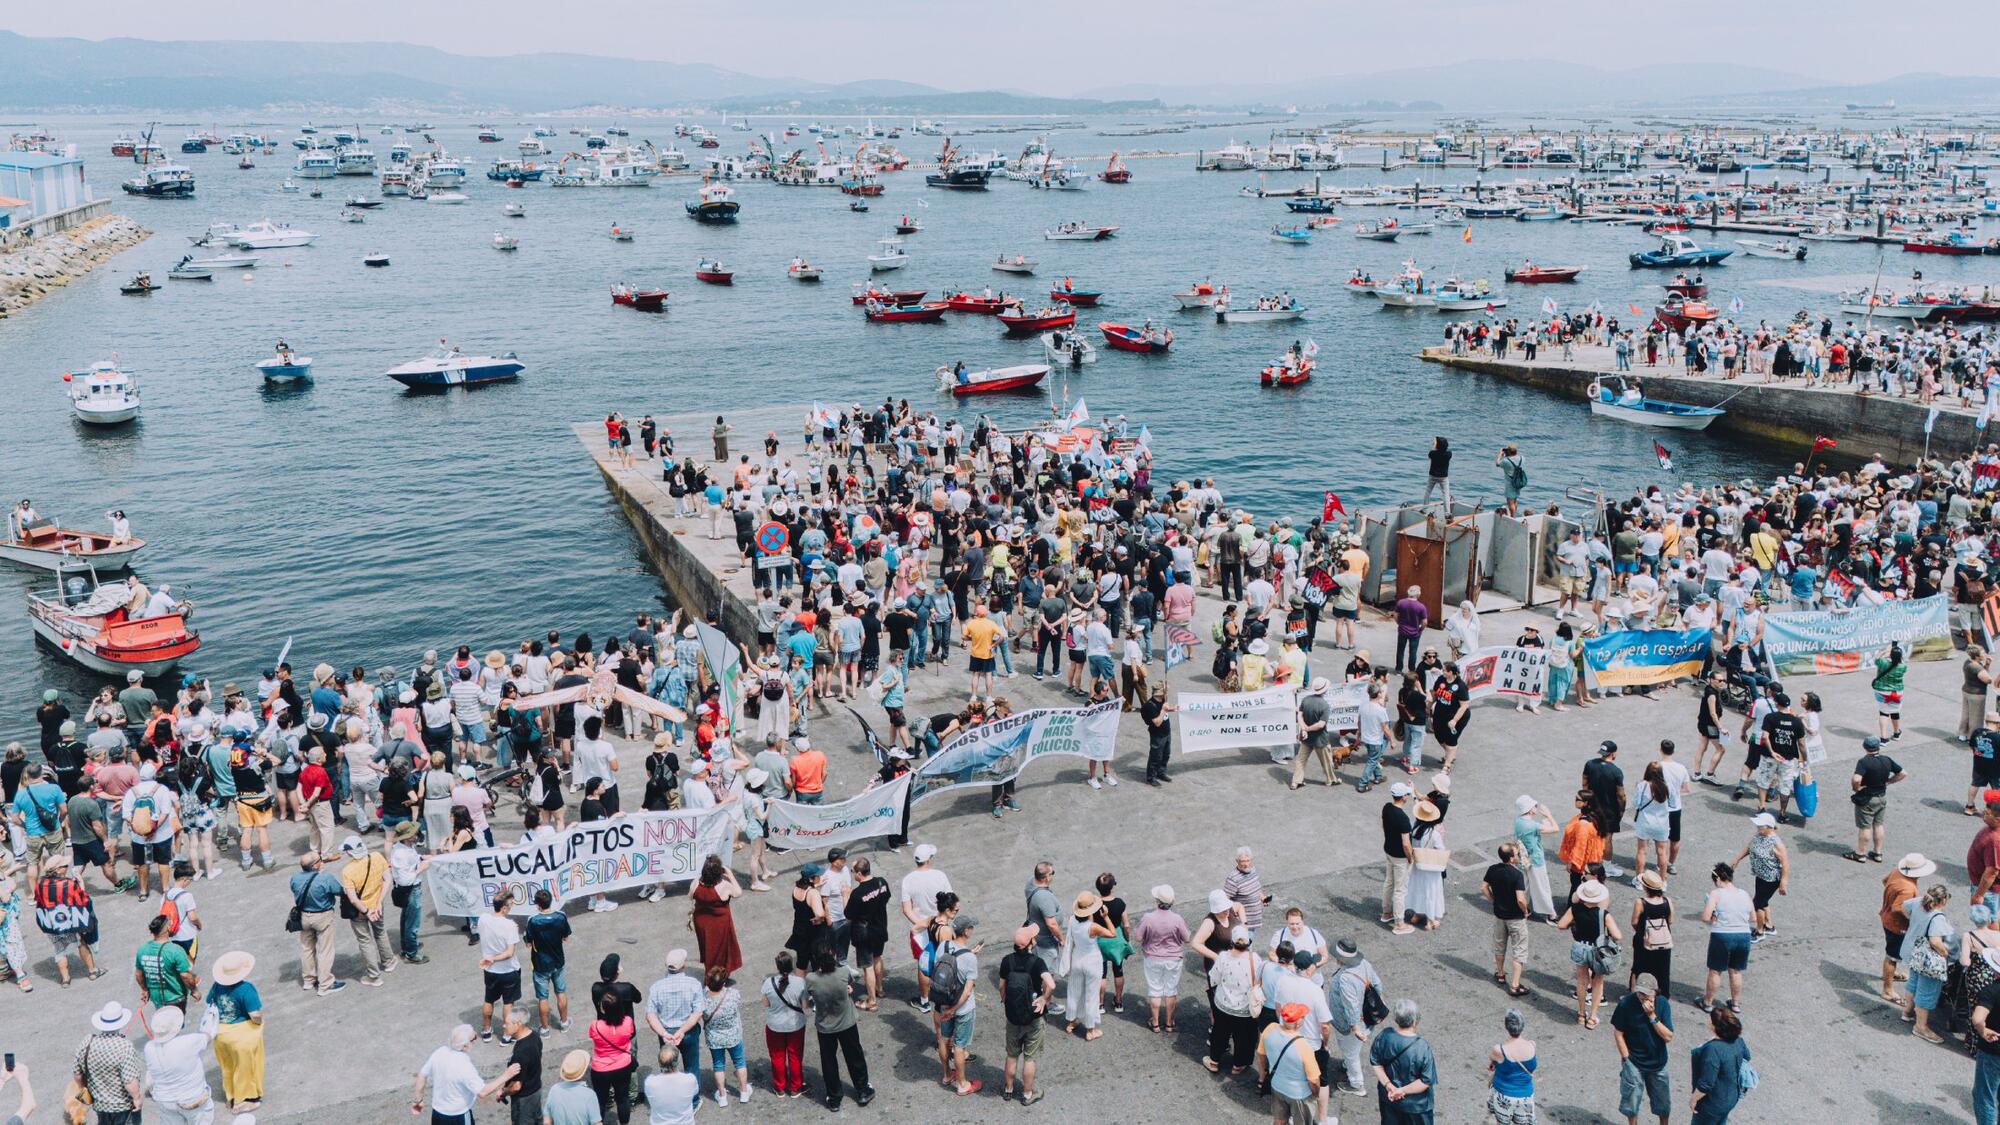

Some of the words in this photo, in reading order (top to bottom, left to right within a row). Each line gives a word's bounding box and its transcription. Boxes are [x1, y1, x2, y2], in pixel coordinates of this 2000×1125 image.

[1787, 640, 1819, 653] UNHA
[1857, 634, 1881, 648] VIVA
[1503, 678, 1542, 694] NON
[1231, 698, 1252, 709] NON
[1254, 697, 1266, 706] SE
[1211, 713, 1249, 721] VENDE
[1041, 725, 1074, 739] MAIS
[1220, 726, 1241, 735] NON
[1245, 725, 1258, 734] SE
[1261, 724, 1289, 733] TOCA
[231, 750, 242, 763] 10
[476, 823, 635, 880] EUCALIPTOS
[643, 816, 698, 848] NON
[671, 841, 698, 875] SI
[36, 904, 90, 932] NON
